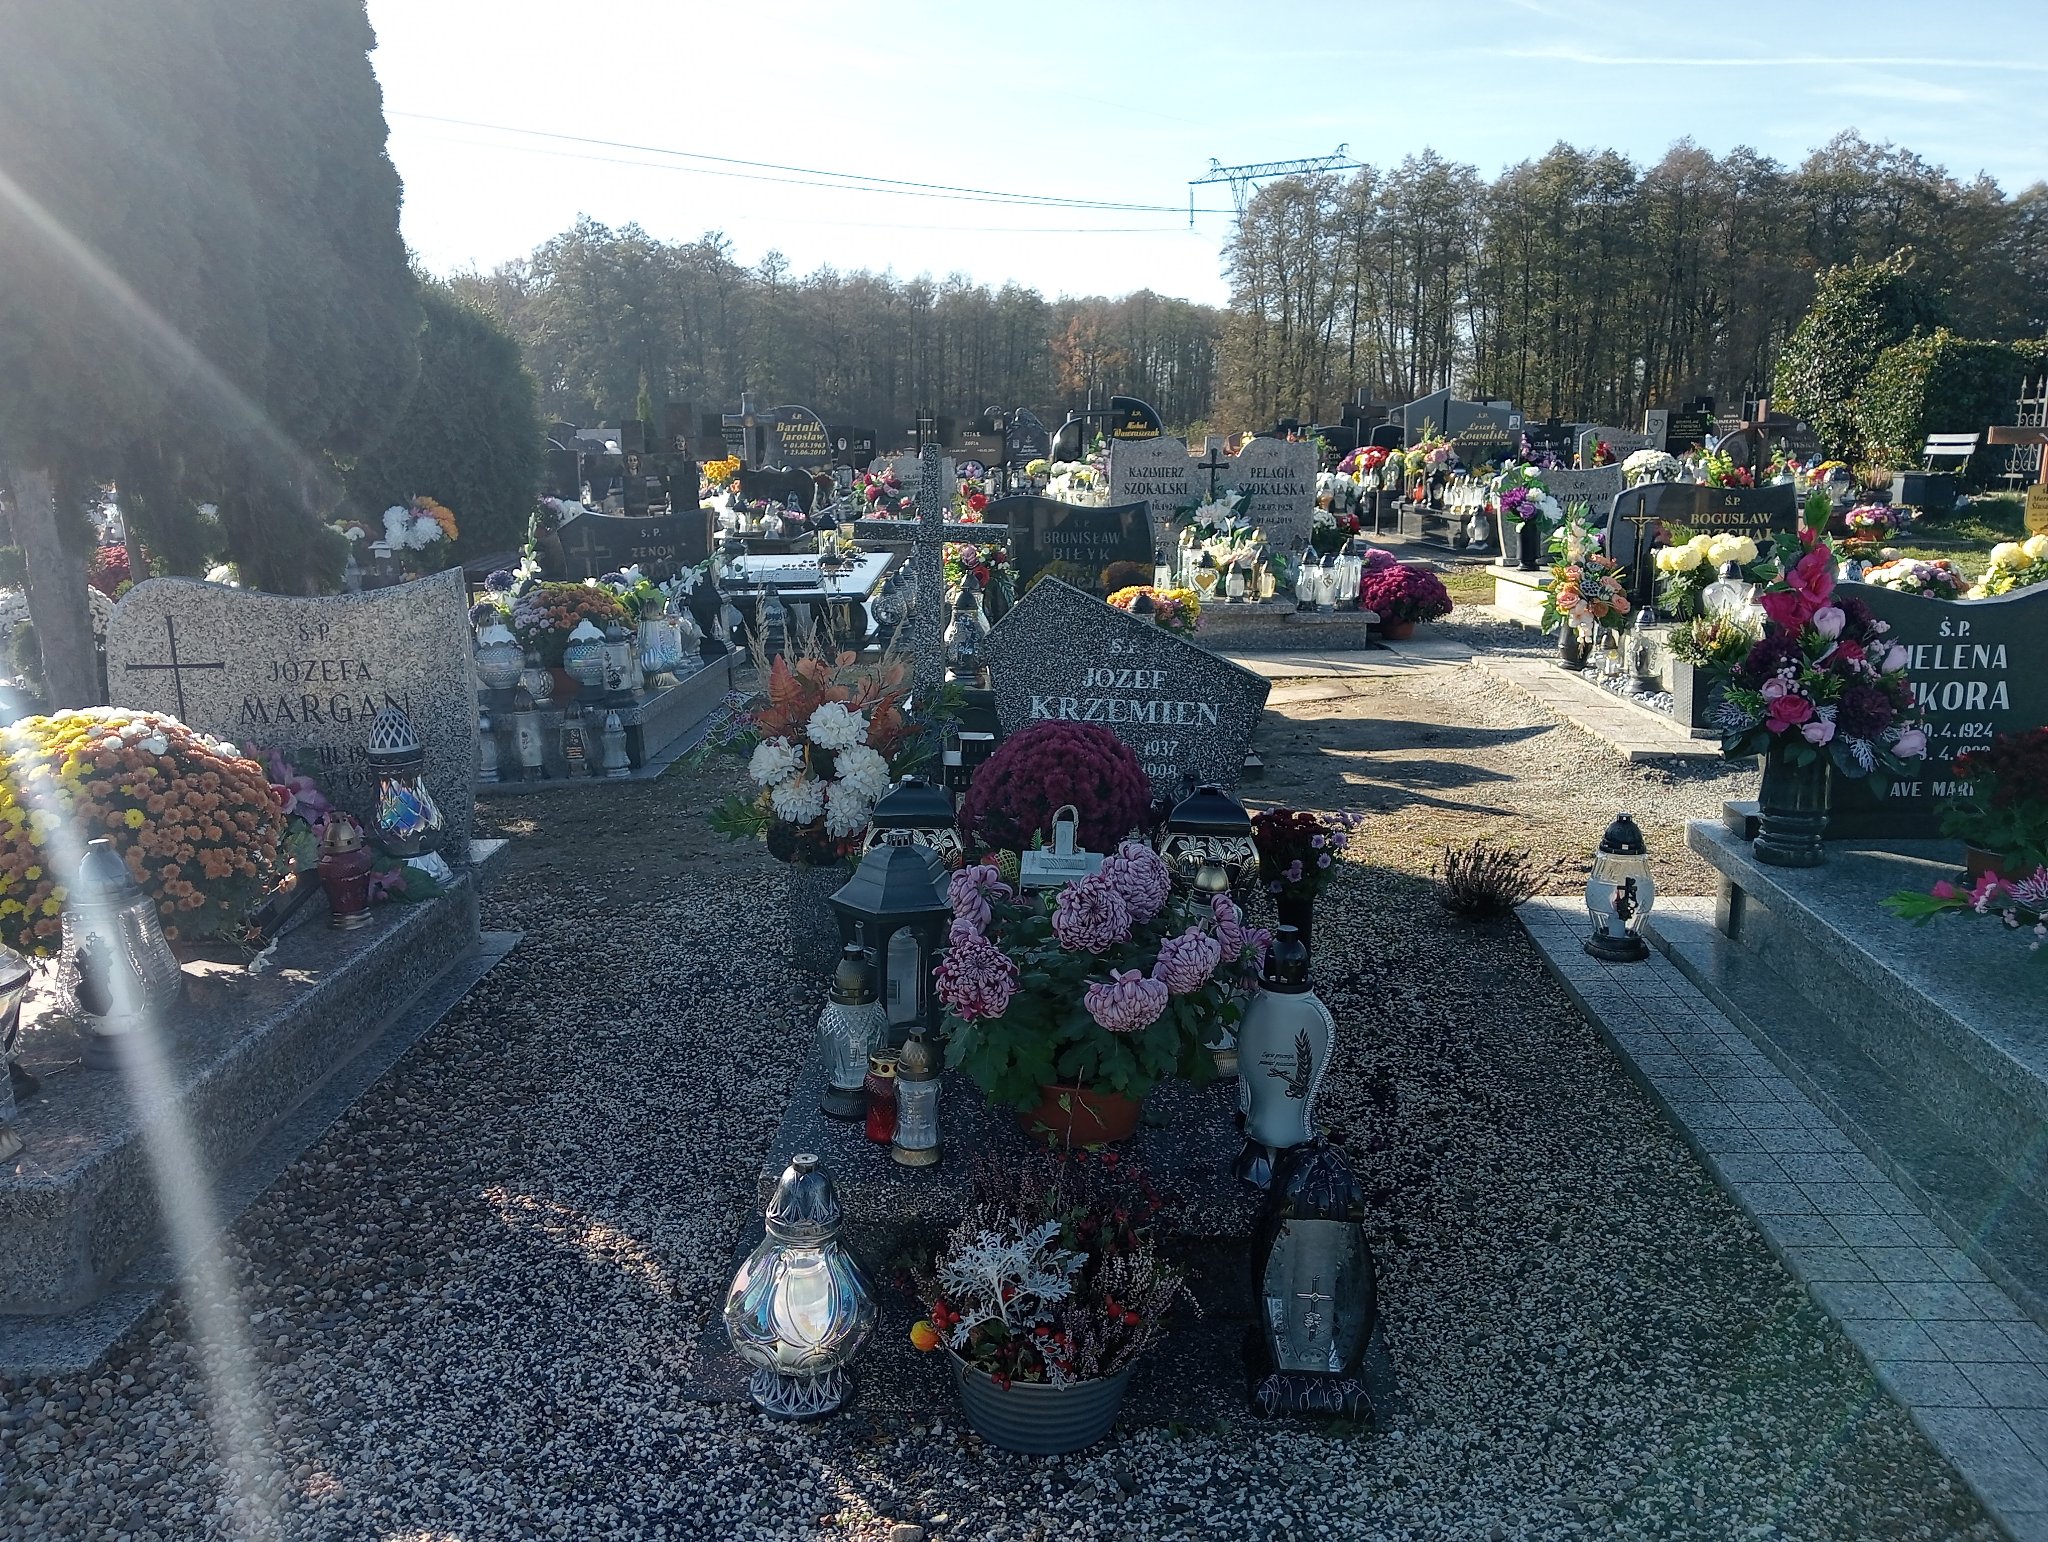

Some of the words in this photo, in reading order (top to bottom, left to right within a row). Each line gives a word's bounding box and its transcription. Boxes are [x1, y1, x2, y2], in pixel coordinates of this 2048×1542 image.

[775, 421, 822, 432] Bartnik
[1457, 430, 1511, 441] Kowalski
[1128, 466, 1185, 478] KAZIMIERZ
[1250, 466, 1296, 479] PELAGIA
[1124, 482, 1188, 495] SZOKALSKI
[1239, 482, 1306, 496] SZOKALSKA
[1043, 530, 1121, 545] BRONISŁAW
[631, 545, 676, 558] ZENON
[1052, 548, 1111, 561] BIŁYK
[1907, 681, 2010, 711] IKORA
[1144, 740, 1180, 757] 1937
[1889, 781, 1923, 797] AVE
